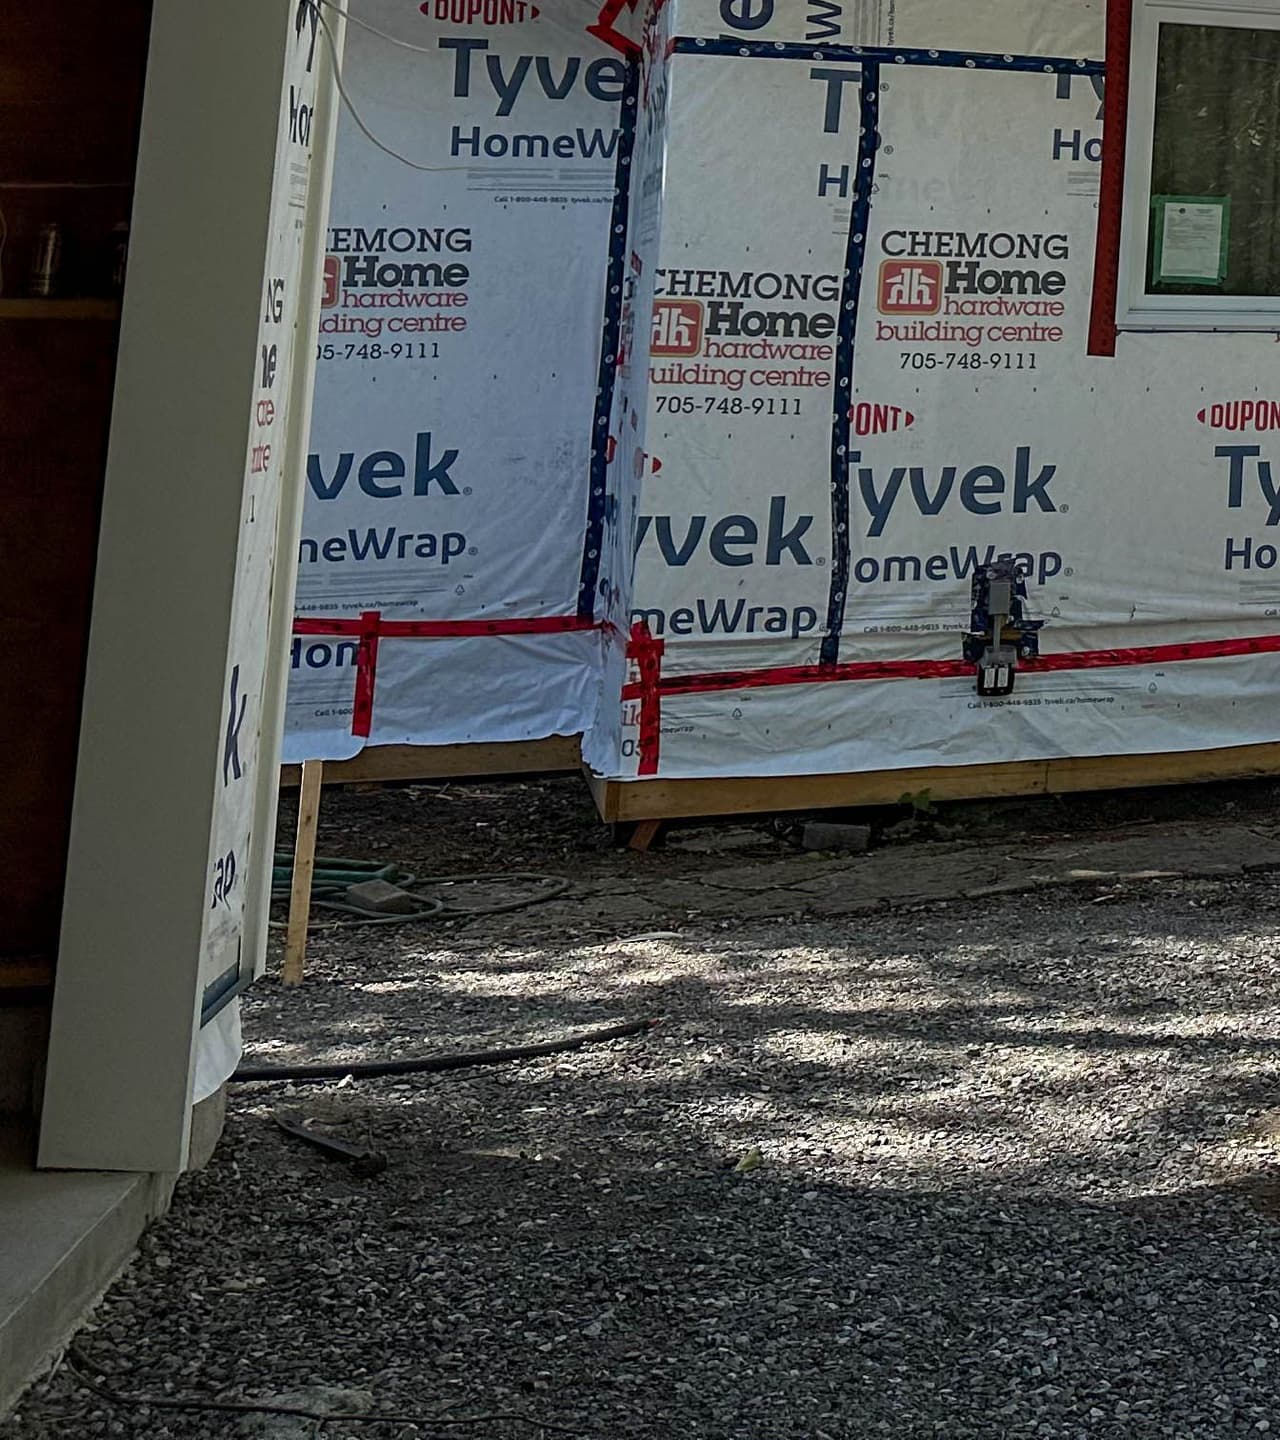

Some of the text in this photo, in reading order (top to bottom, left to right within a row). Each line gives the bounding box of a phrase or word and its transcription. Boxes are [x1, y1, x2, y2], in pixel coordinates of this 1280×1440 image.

[881, 230, 1069, 259] CHEMONG
[342, 255, 470, 288] Home
[945, 261, 1066, 295] Home
[342, 289, 468, 308] hardware
[944, 296, 1065, 316] hardware
[388, 314, 468, 333] centre
[705, 301, 836, 338] Home
[876, 320, 1064, 345] building centre
[703, 338, 833, 361] hardware
[900, 352, 1037, 370] 705-748-9111
[649, 365, 832, 391] uilding centre
[656, 396, 802, 417] 705-748-9111
[849, 447, 1057, 537] yvek
